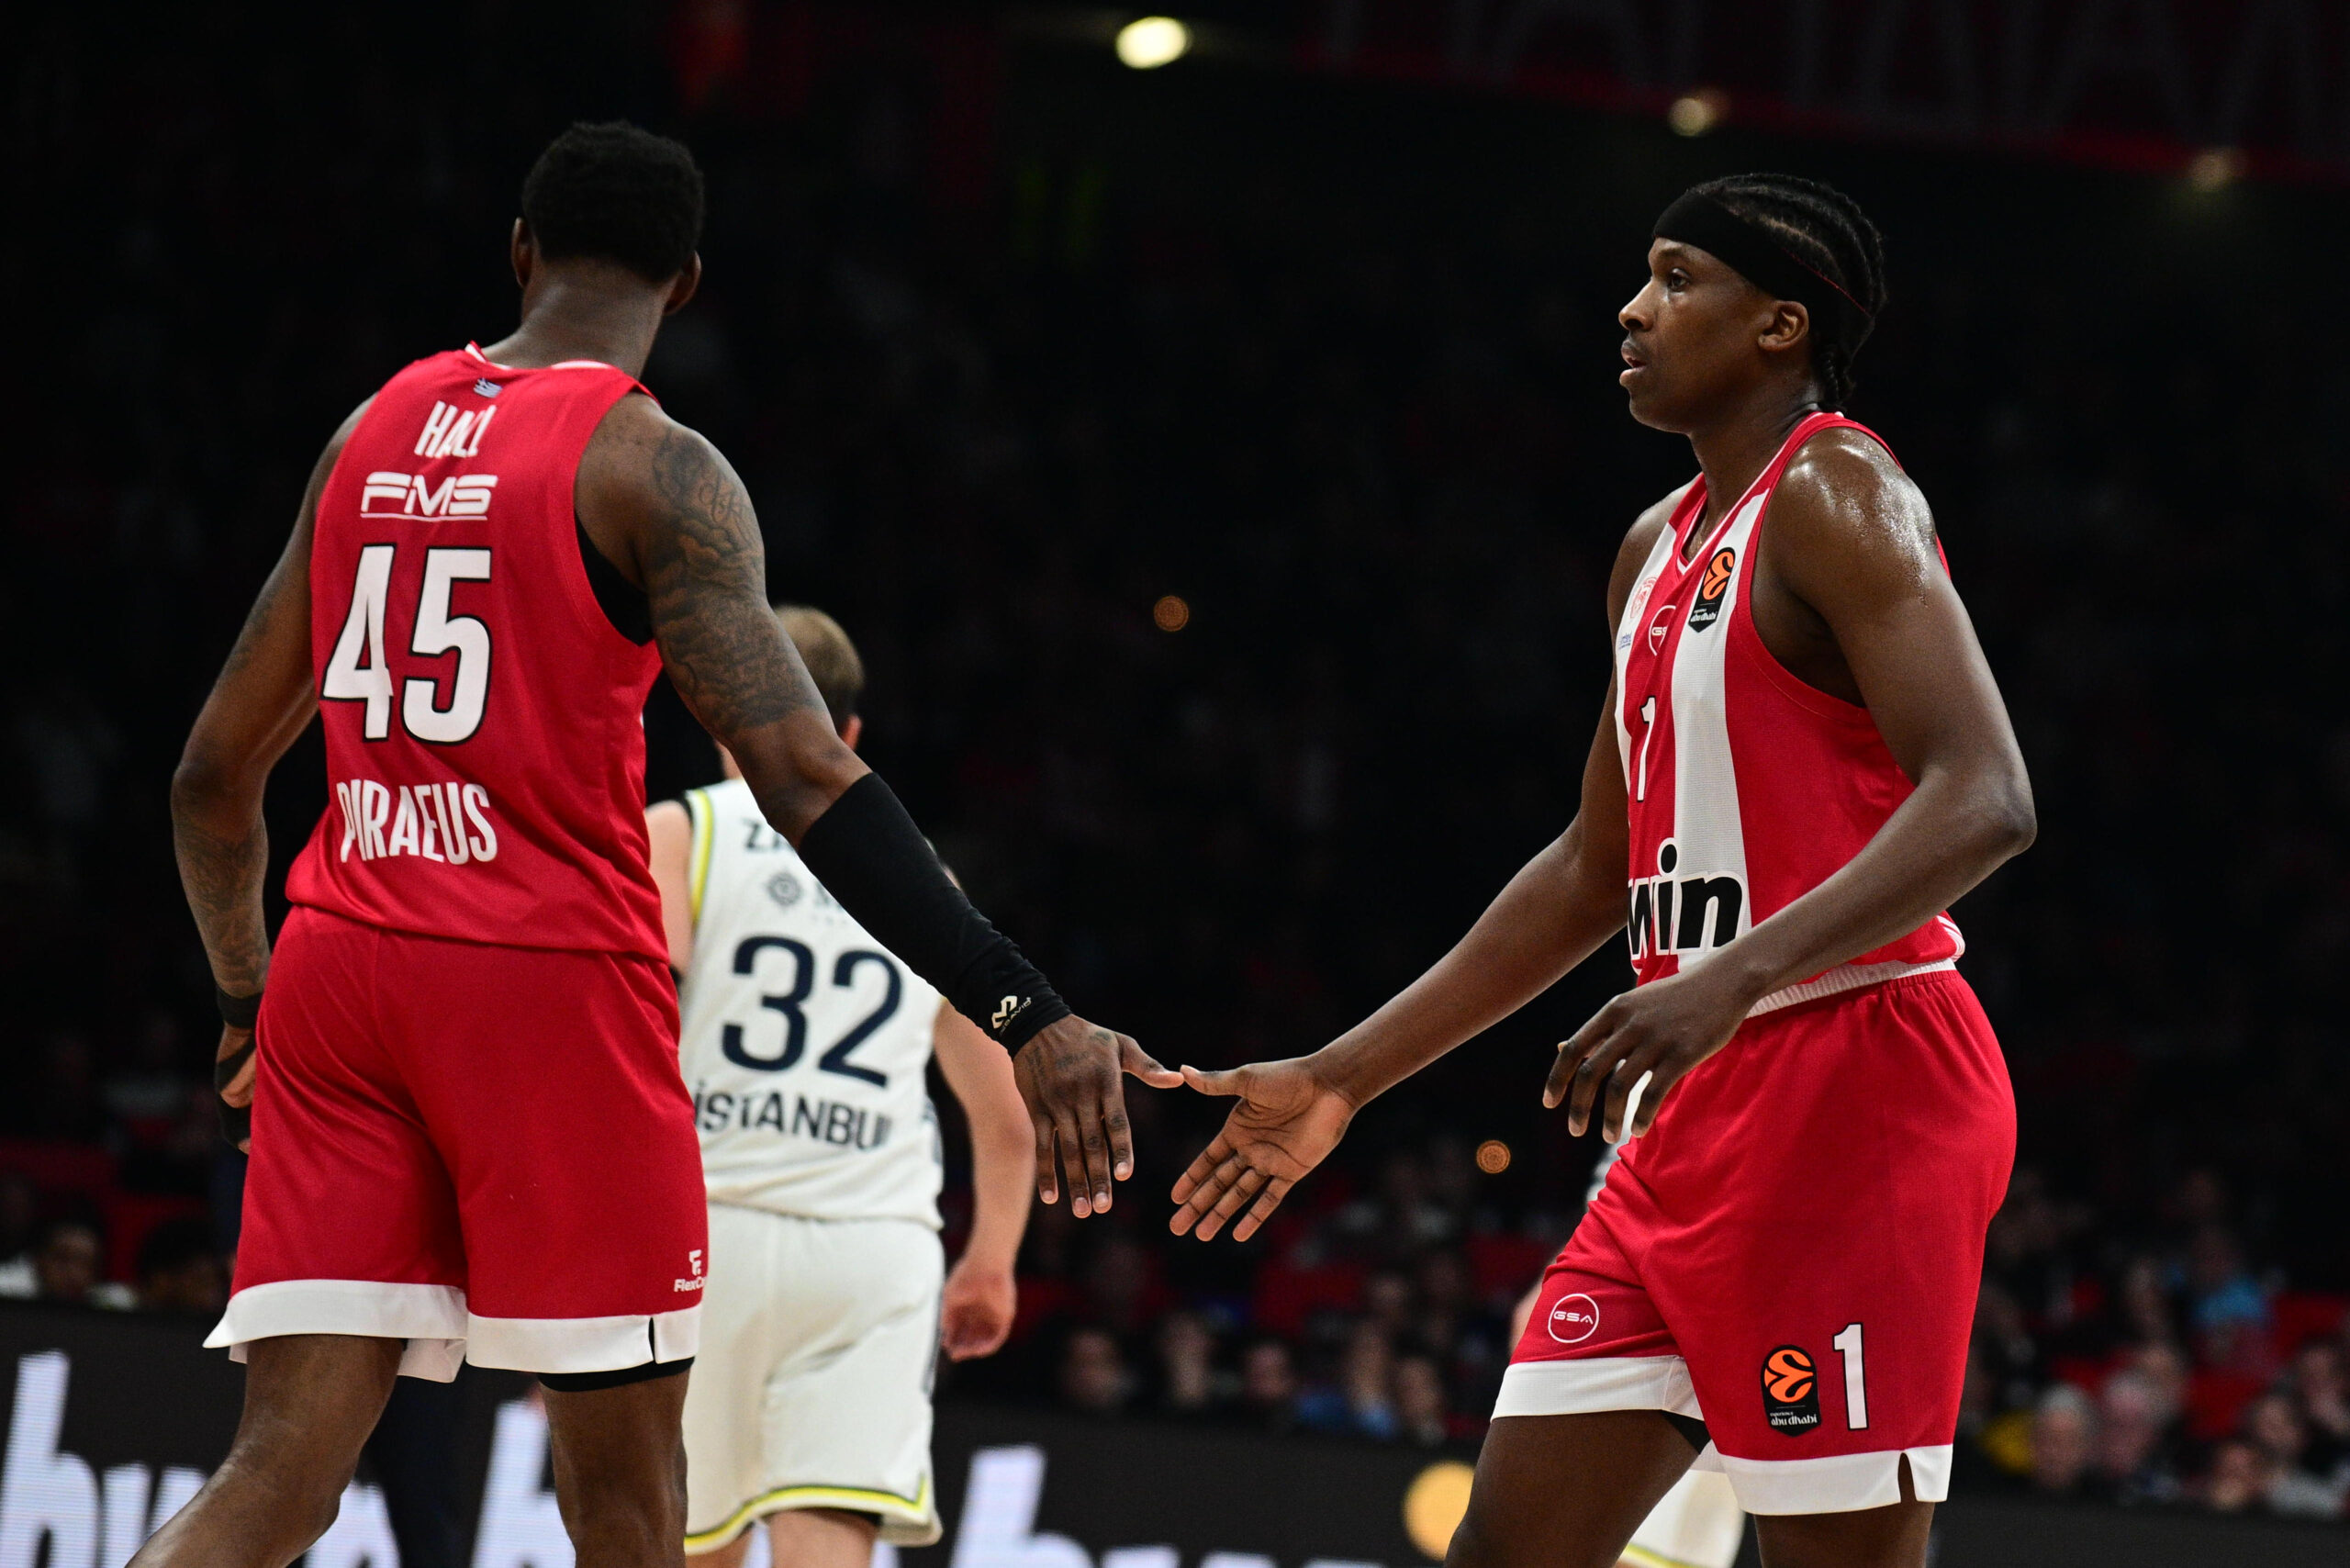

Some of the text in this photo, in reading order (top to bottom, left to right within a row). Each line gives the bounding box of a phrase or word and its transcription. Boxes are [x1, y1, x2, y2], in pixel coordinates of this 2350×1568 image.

[414, 400, 498, 458] HALL
[361, 472, 498, 516] FMS
[321, 543, 491, 746] 45
[1636, 695, 1656, 802] 1
[336, 778, 498, 866] PIRAEUS
[721, 934, 903, 1090] 32
[1553, 1310, 1594, 1325] GSA
[1771, 1414, 1818, 1426] abu dhabi
[1832, 1322, 1870, 1430] 1
